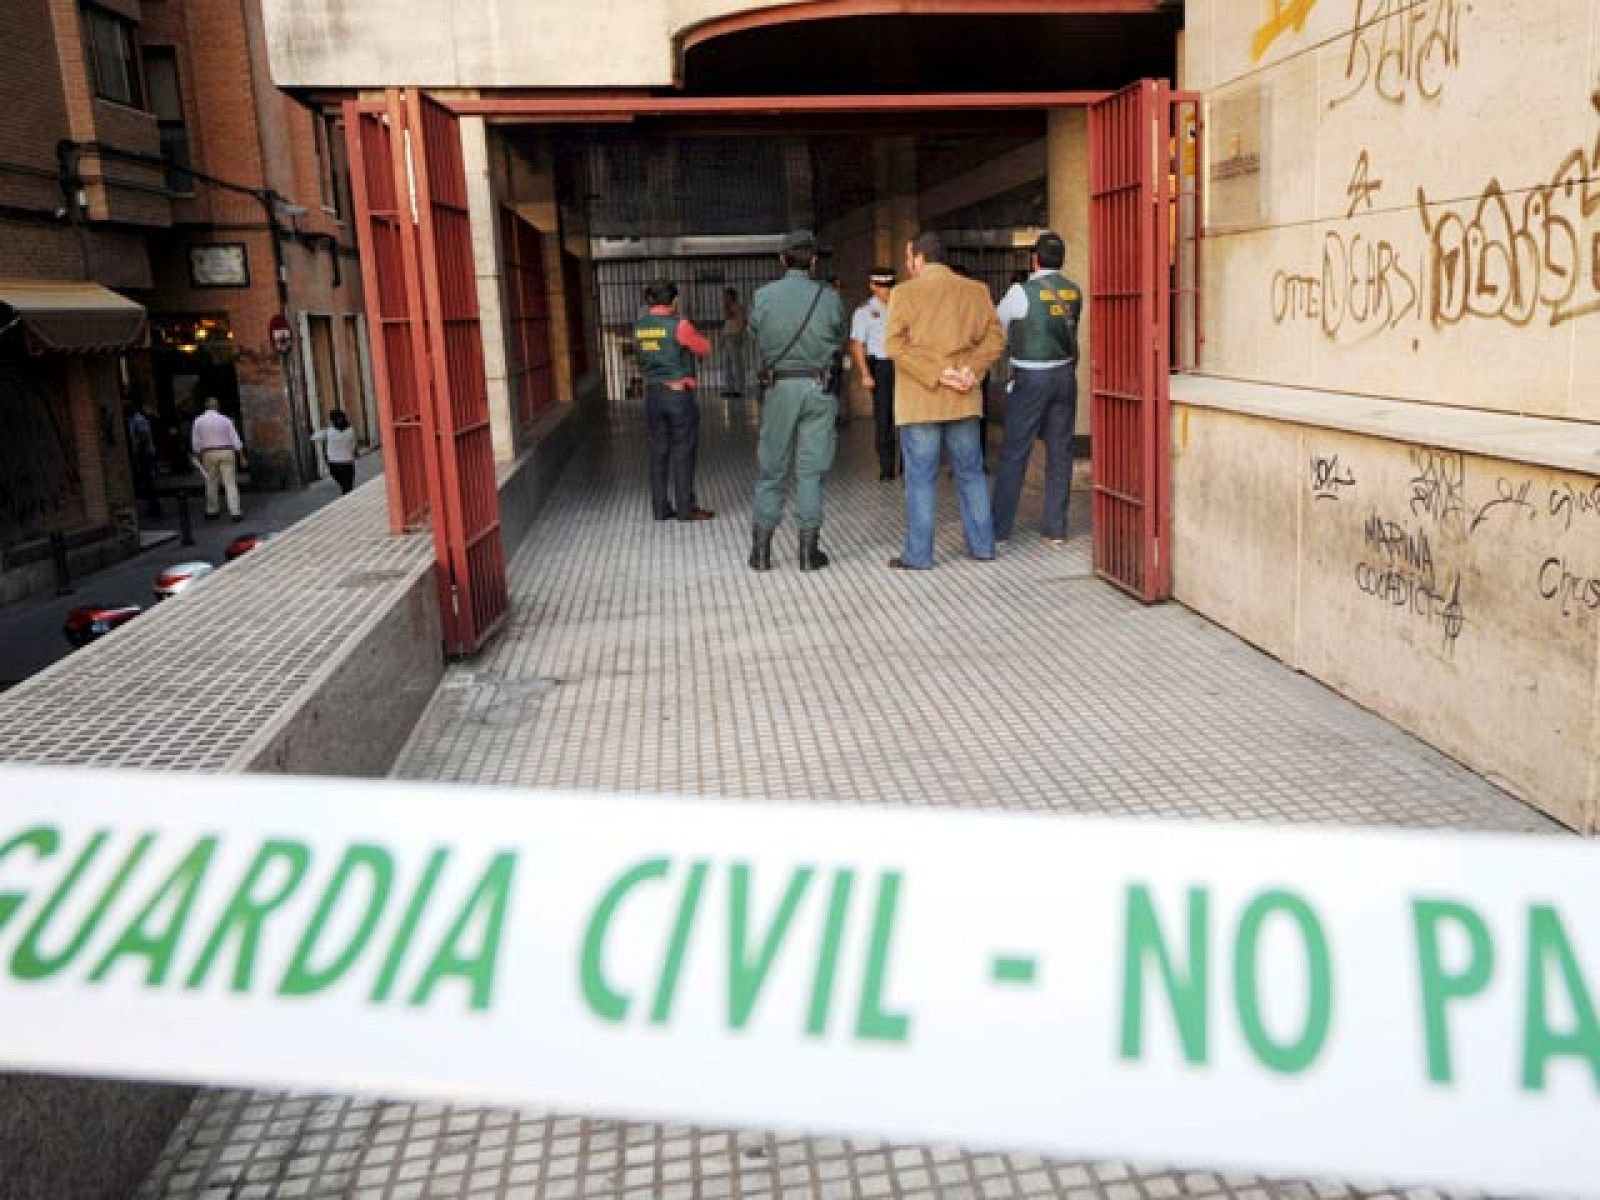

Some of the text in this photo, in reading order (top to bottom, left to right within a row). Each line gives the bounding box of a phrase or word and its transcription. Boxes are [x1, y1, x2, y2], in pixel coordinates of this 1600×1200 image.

[0, 824, 519, 1012] GUARDIA
[579, 855, 911, 1043] CIVIL
[1118, 882, 1332, 1075] NO
